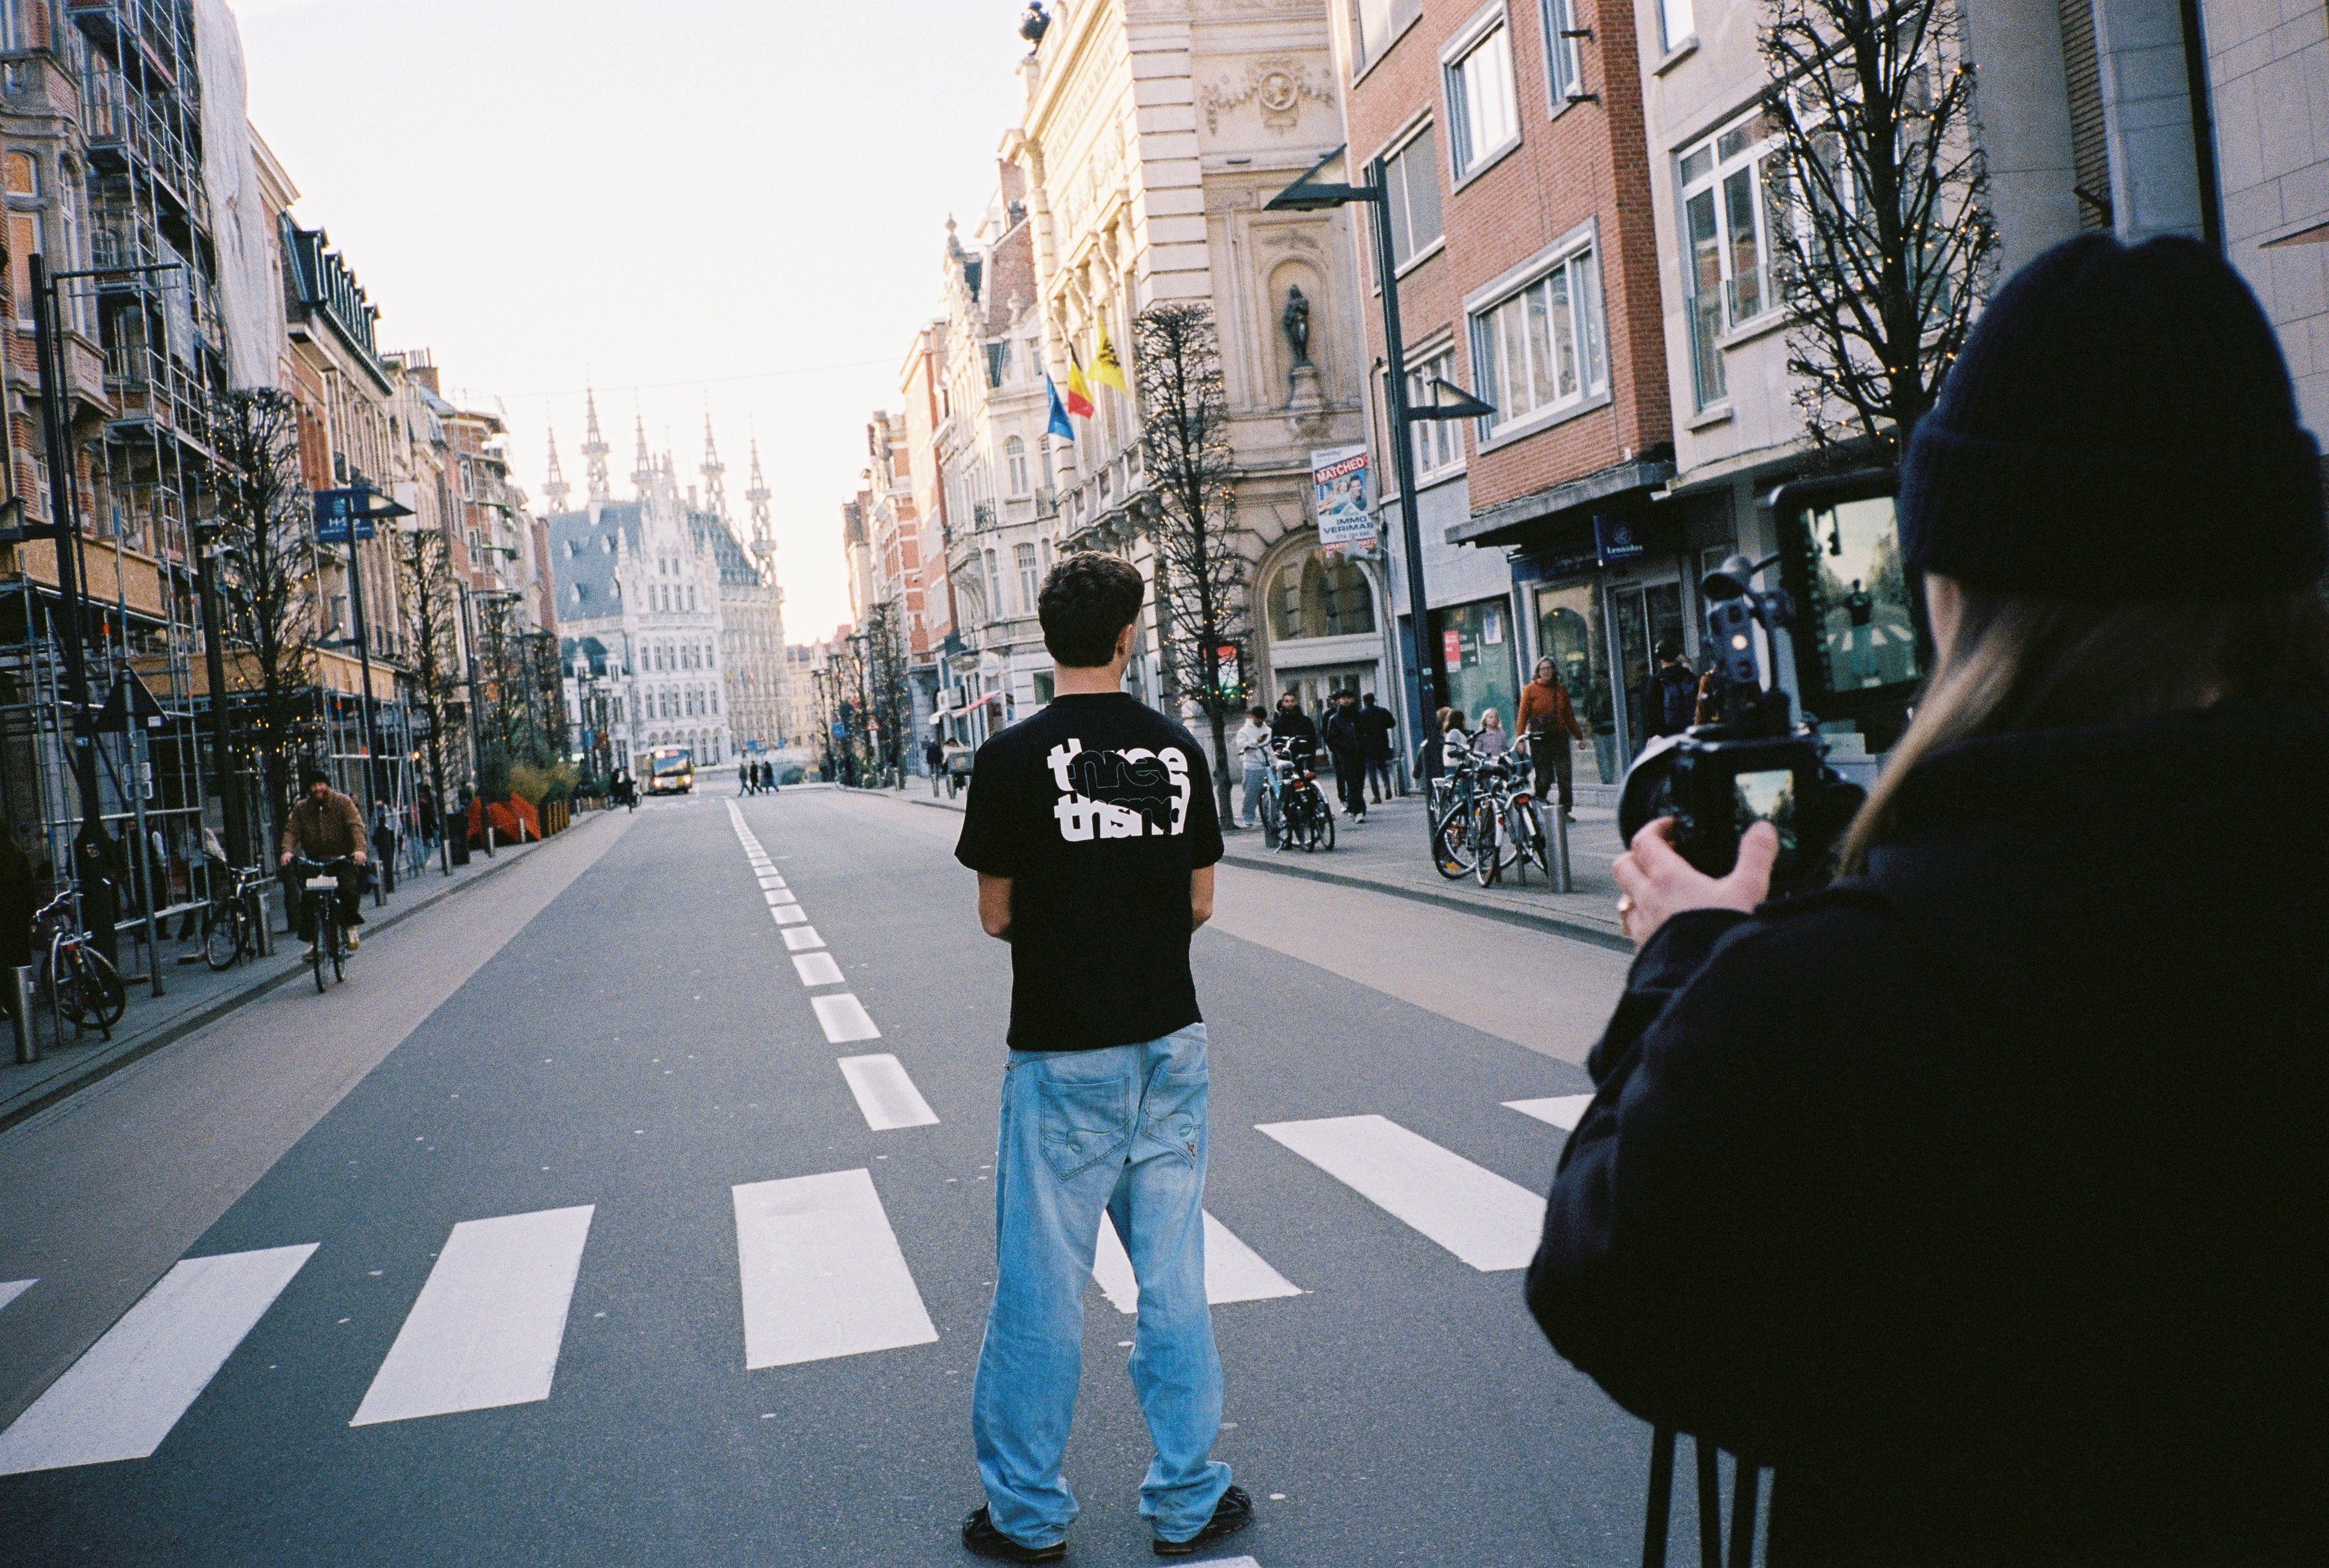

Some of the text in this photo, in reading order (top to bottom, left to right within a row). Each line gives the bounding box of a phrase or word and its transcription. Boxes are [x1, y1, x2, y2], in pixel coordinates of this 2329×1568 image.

[1316, 457, 1364, 482] MATCHED
[1336, 516, 1367, 525] IMMO
[1323, 522, 1373, 534] VERIMAS
